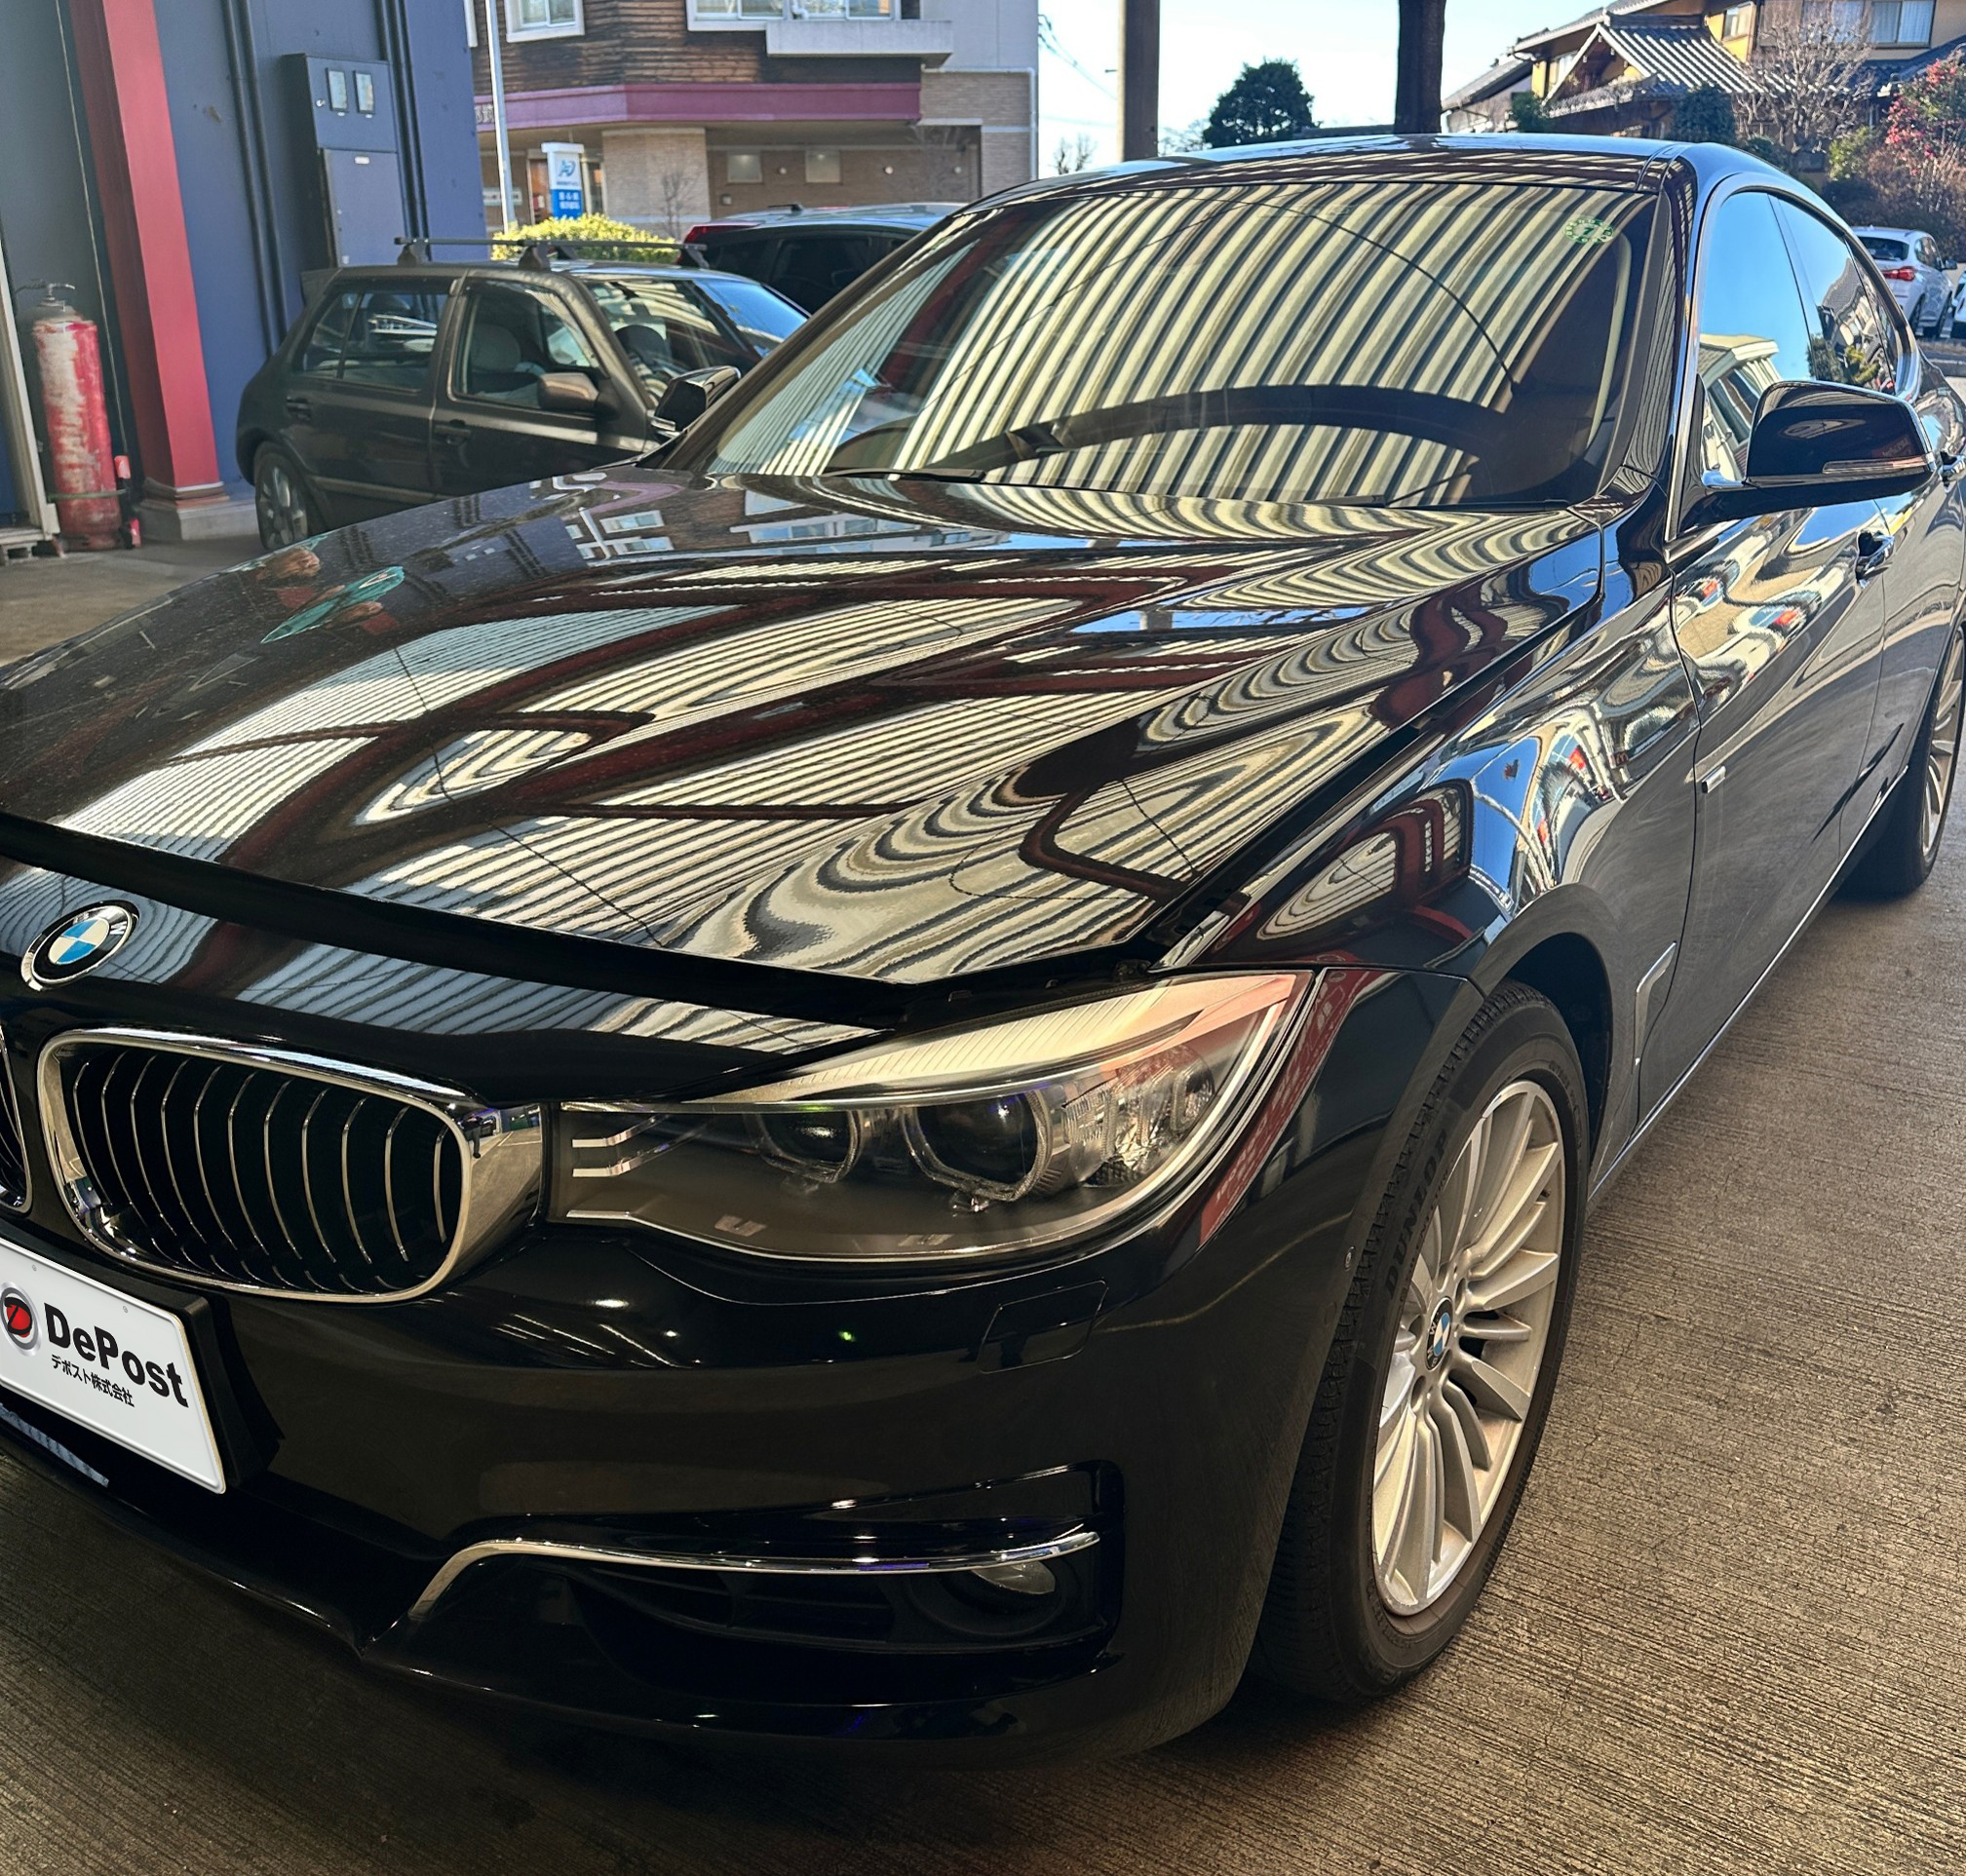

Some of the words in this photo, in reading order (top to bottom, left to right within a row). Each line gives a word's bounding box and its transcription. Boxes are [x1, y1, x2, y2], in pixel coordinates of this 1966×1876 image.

[1385, 1129, 1448, 1300] DUNLOP
[44, 1302, 189, 1408] DePost
[51, 1354, 135, 1407] デポスト株式会社
